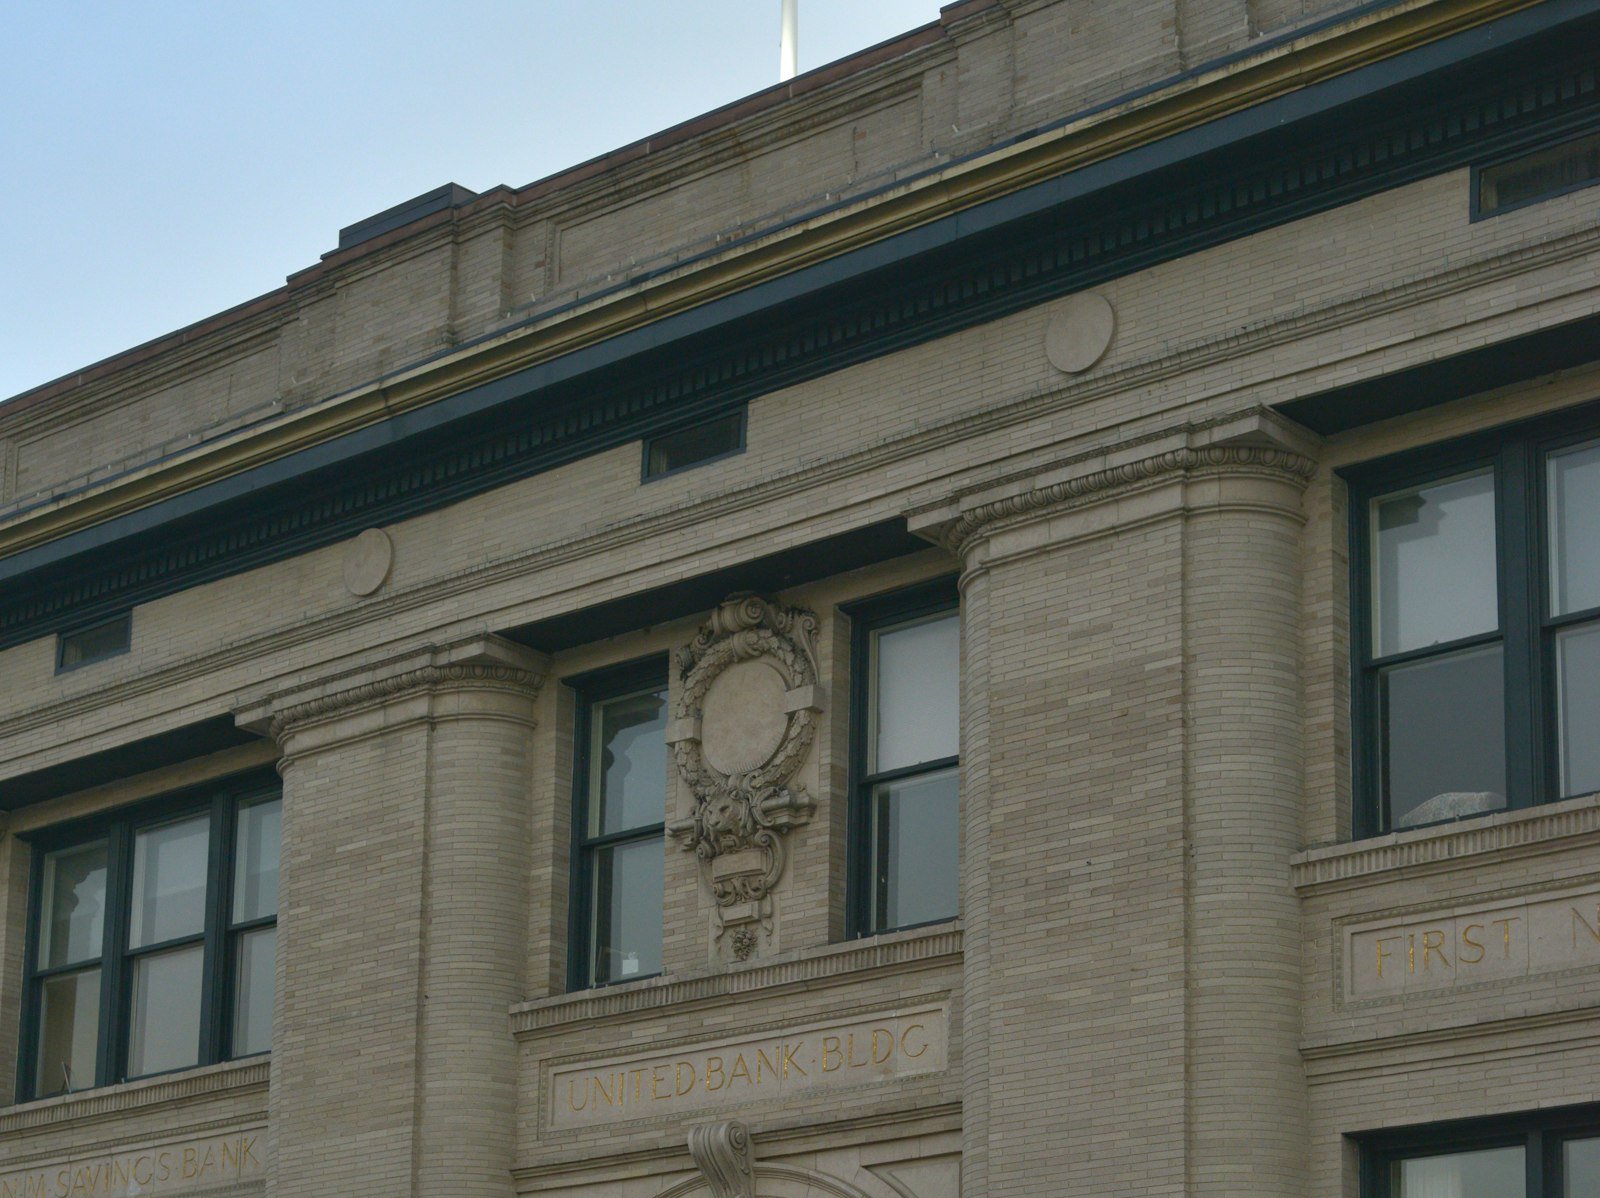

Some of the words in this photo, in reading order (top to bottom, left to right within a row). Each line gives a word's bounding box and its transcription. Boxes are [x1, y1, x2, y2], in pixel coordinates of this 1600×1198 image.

[1375, 916, 1521, 979] FIRST
[567, 1060, 697, 1112] UNITED
[705, 1040, 807, 1092] BANK
[822, 1024, 929, 1073] BLDG
[182, 1135, 261, 1180] BANK
